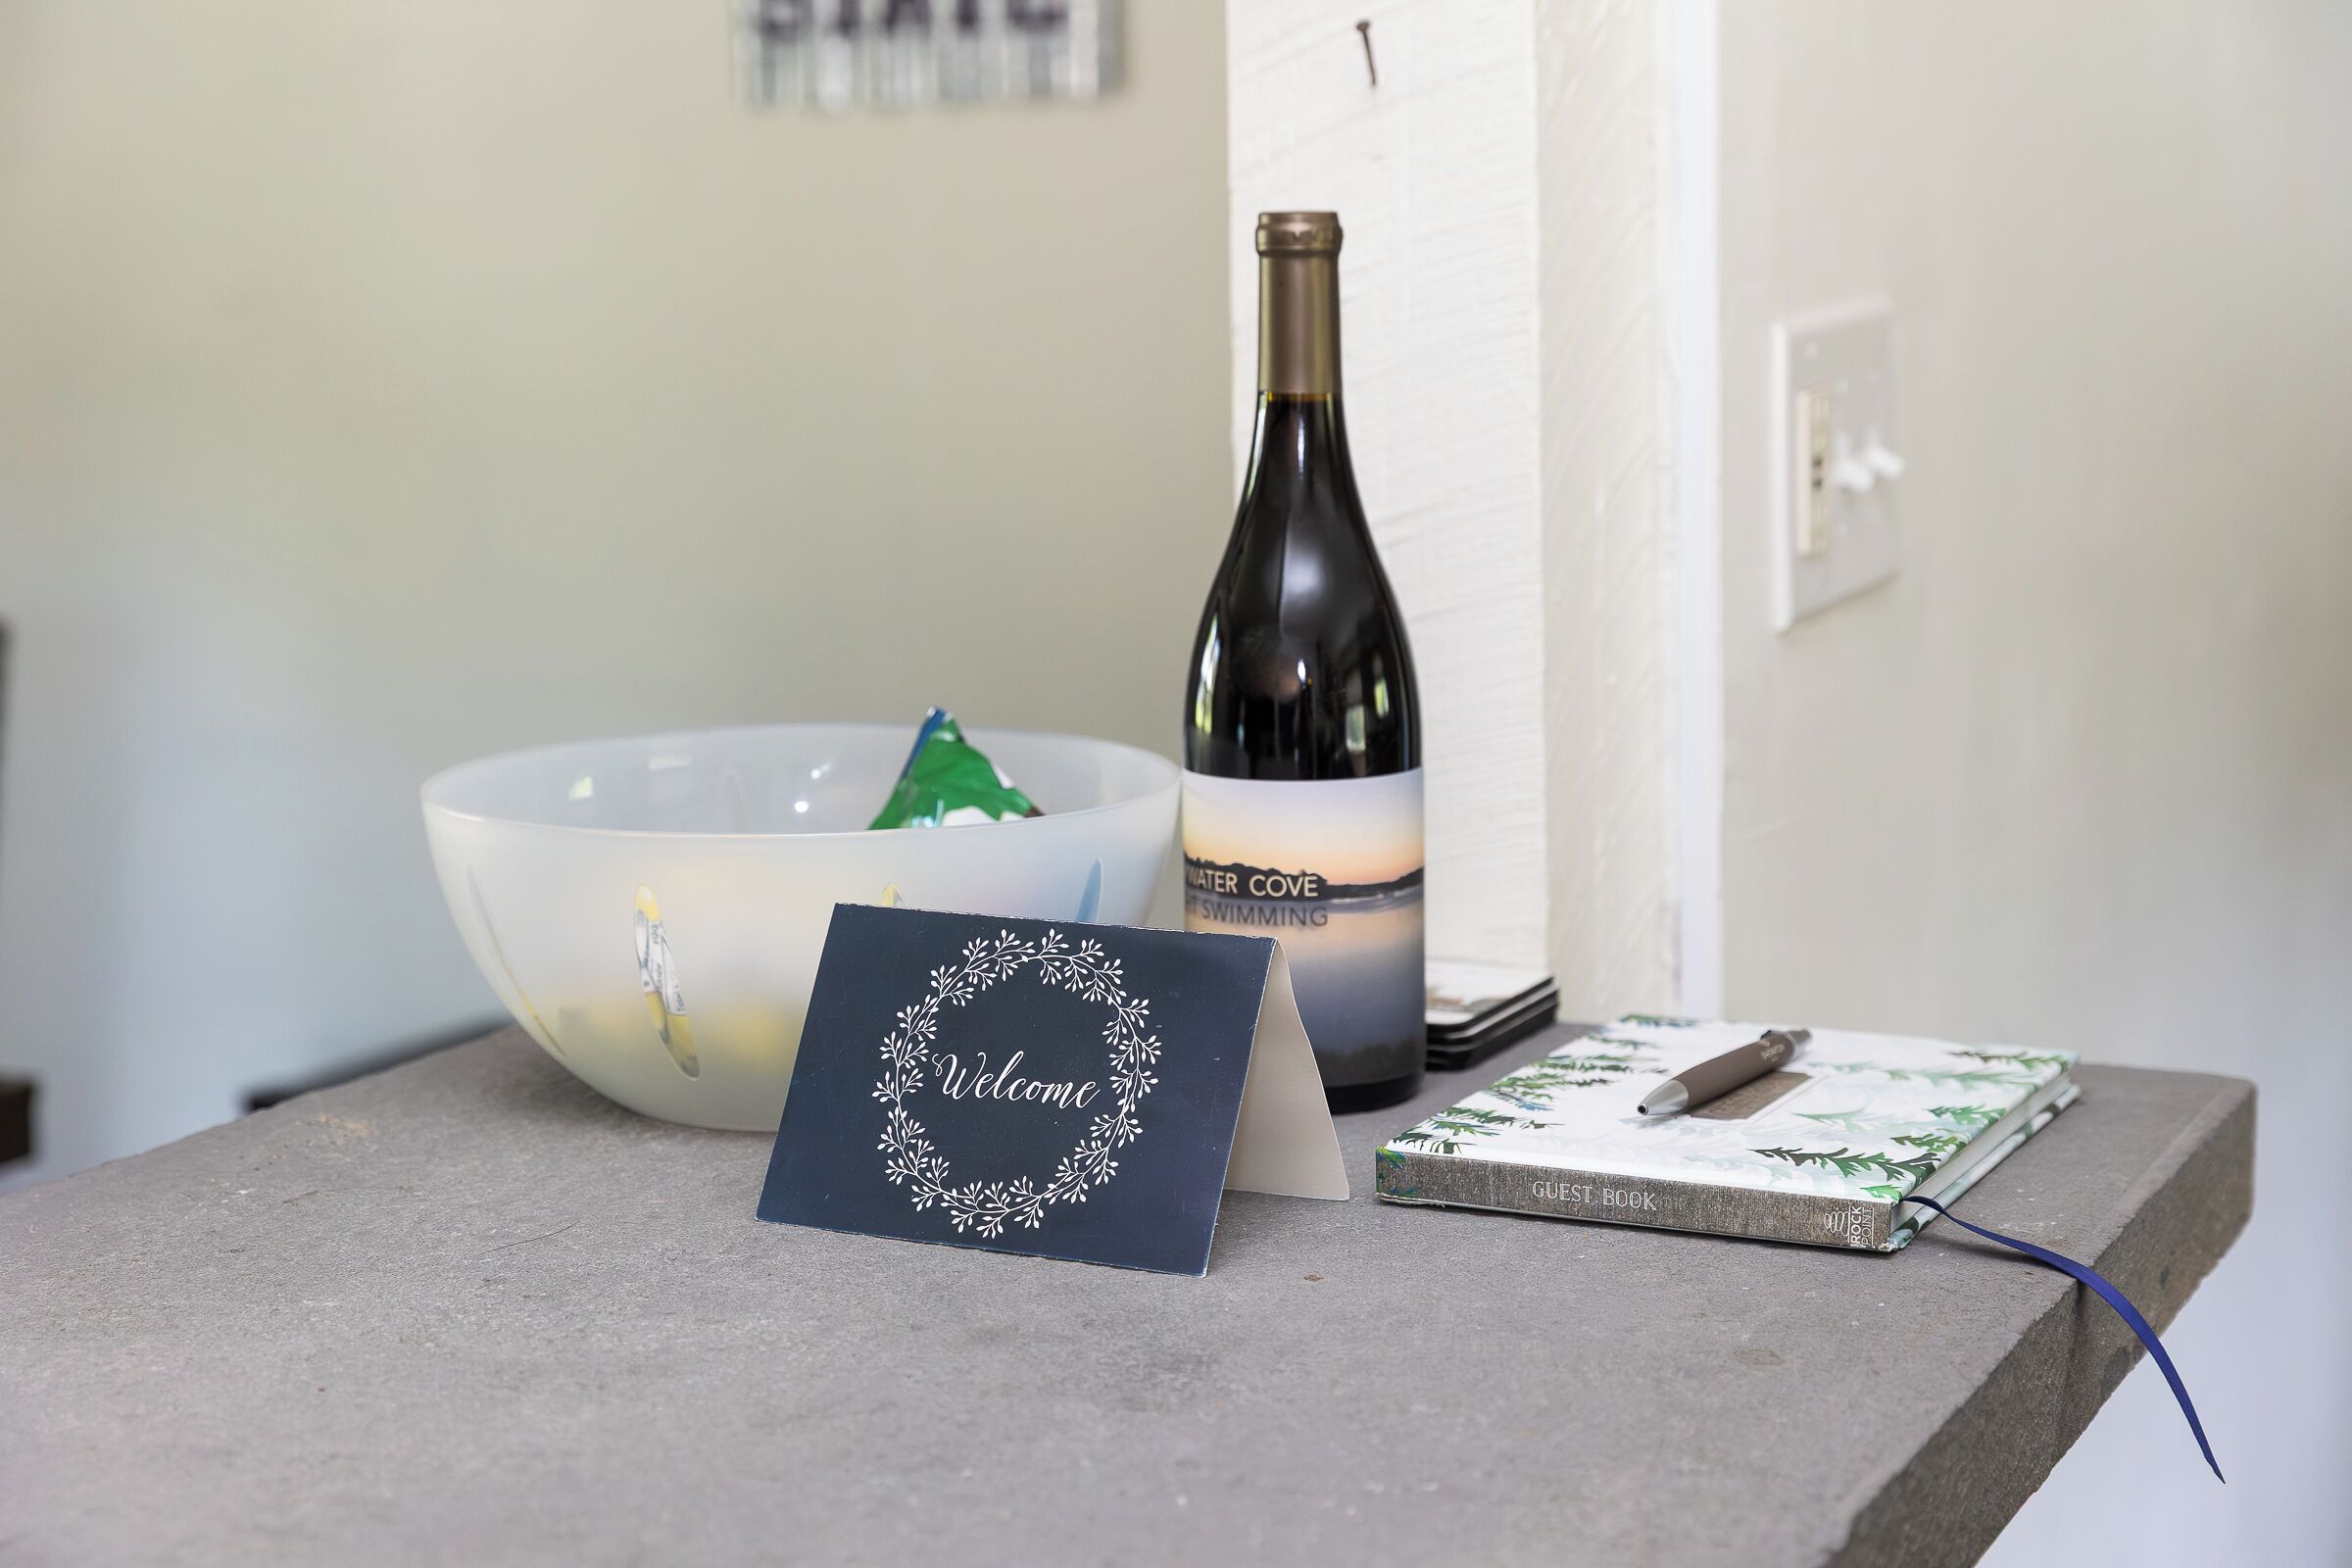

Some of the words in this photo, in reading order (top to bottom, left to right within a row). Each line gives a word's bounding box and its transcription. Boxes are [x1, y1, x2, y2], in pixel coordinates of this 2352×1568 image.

[1250, 875, 1318, 897] COVE
[1202, 899, 1328, 926] SWIMMING
[932, 1051, 1101, 1109] Welcome
[1532, 1181, 1592, 1203] GUEST
[1602, 1188, 1658, 1211] BOOK
[1850, 1206, 1862, 1245] ROCK
[1862, 1207, 1872, 1246] POINT
